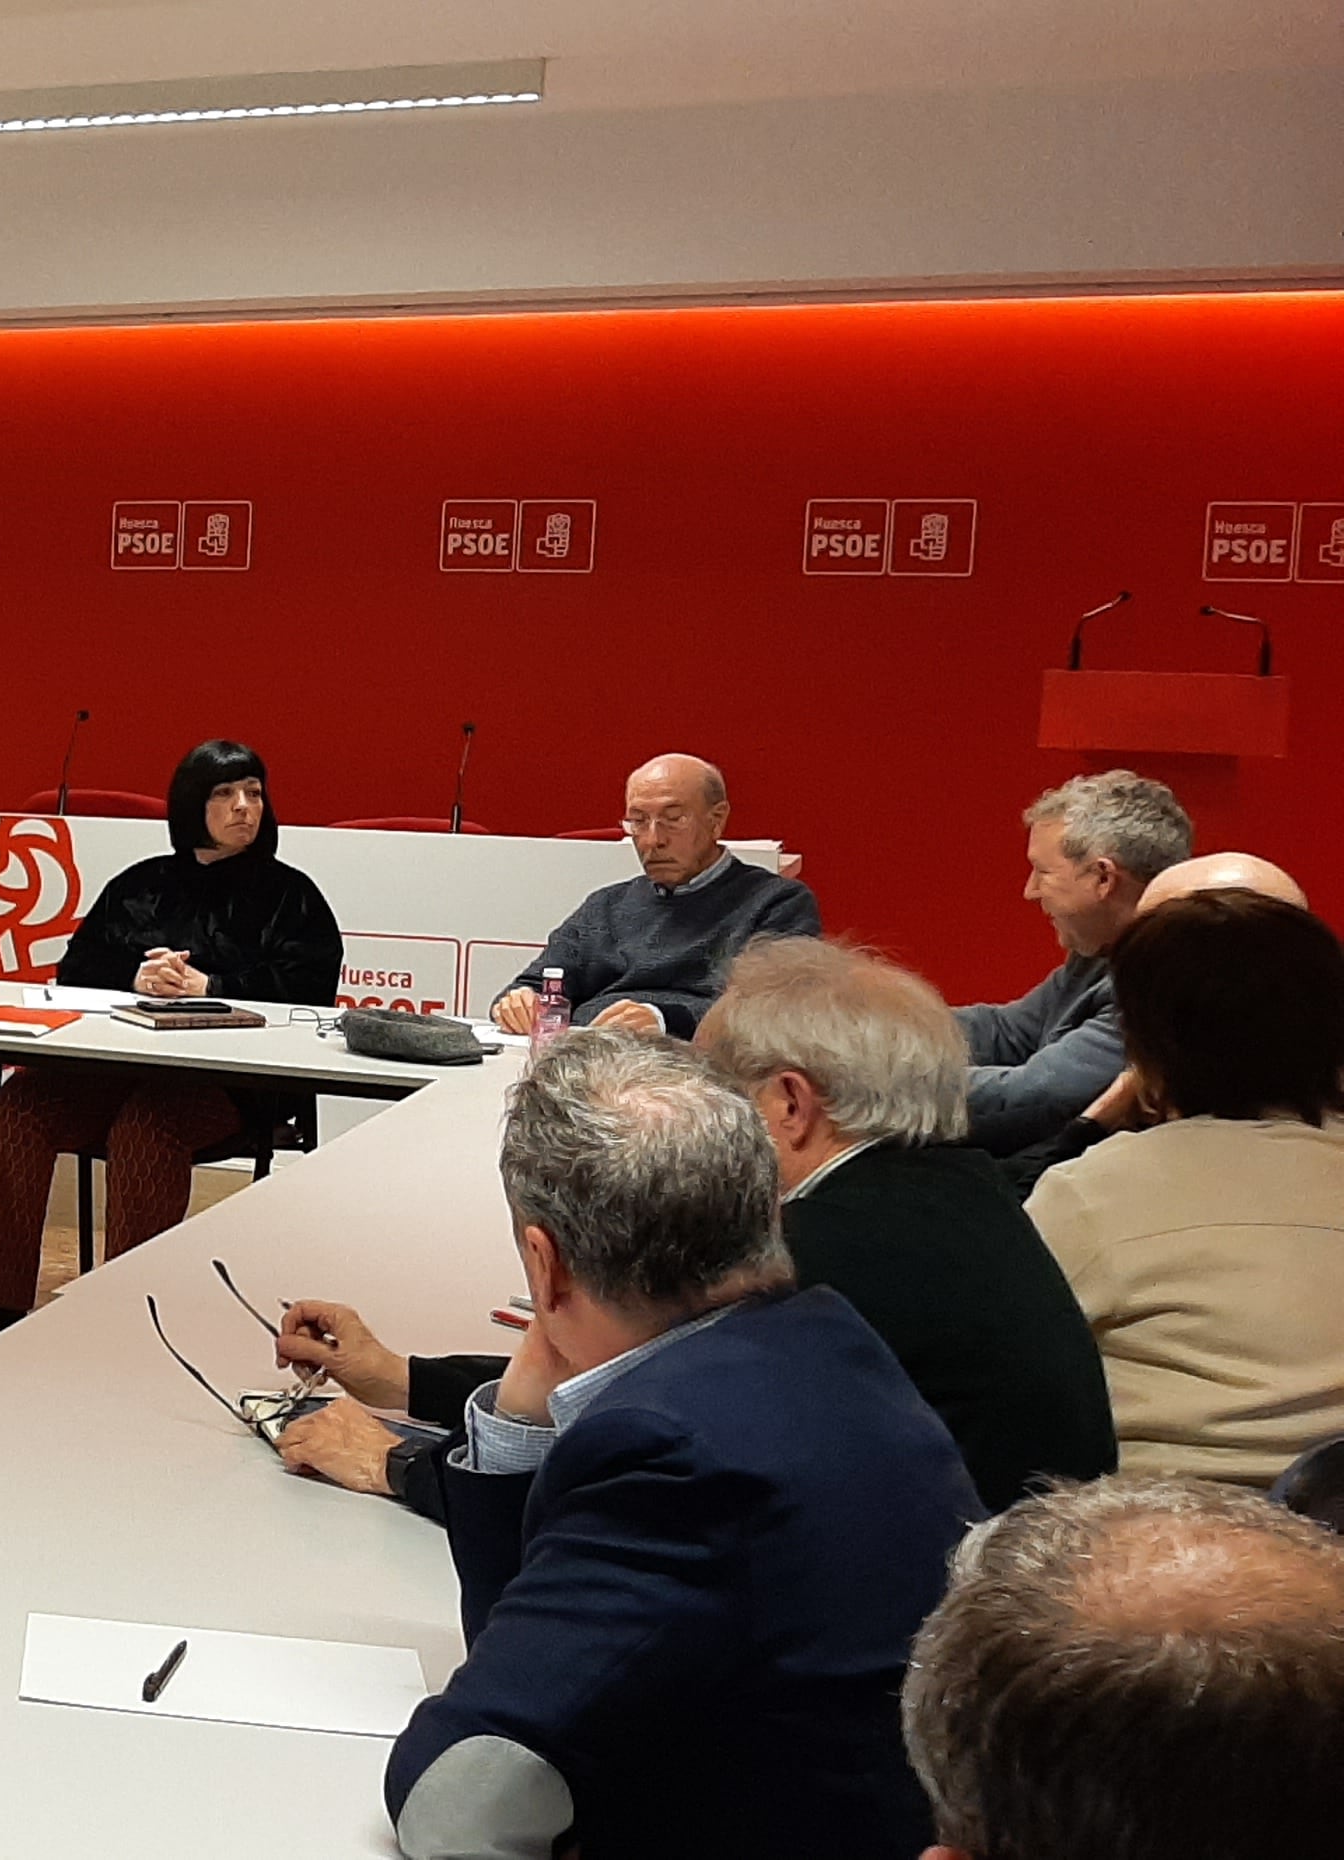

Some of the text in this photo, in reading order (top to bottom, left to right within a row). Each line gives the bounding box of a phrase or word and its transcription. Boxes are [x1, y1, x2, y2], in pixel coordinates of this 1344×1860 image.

[813, 517, 862, 530] Huesca
[1214, 519, 1267, 534] Huesca
[117, 532, 174, 555] PSOE
[447, 532, 510, 556] PSOE
[811, 534, 881, 558] PSOE
[1211, 538, 1288, 564] PSOE
